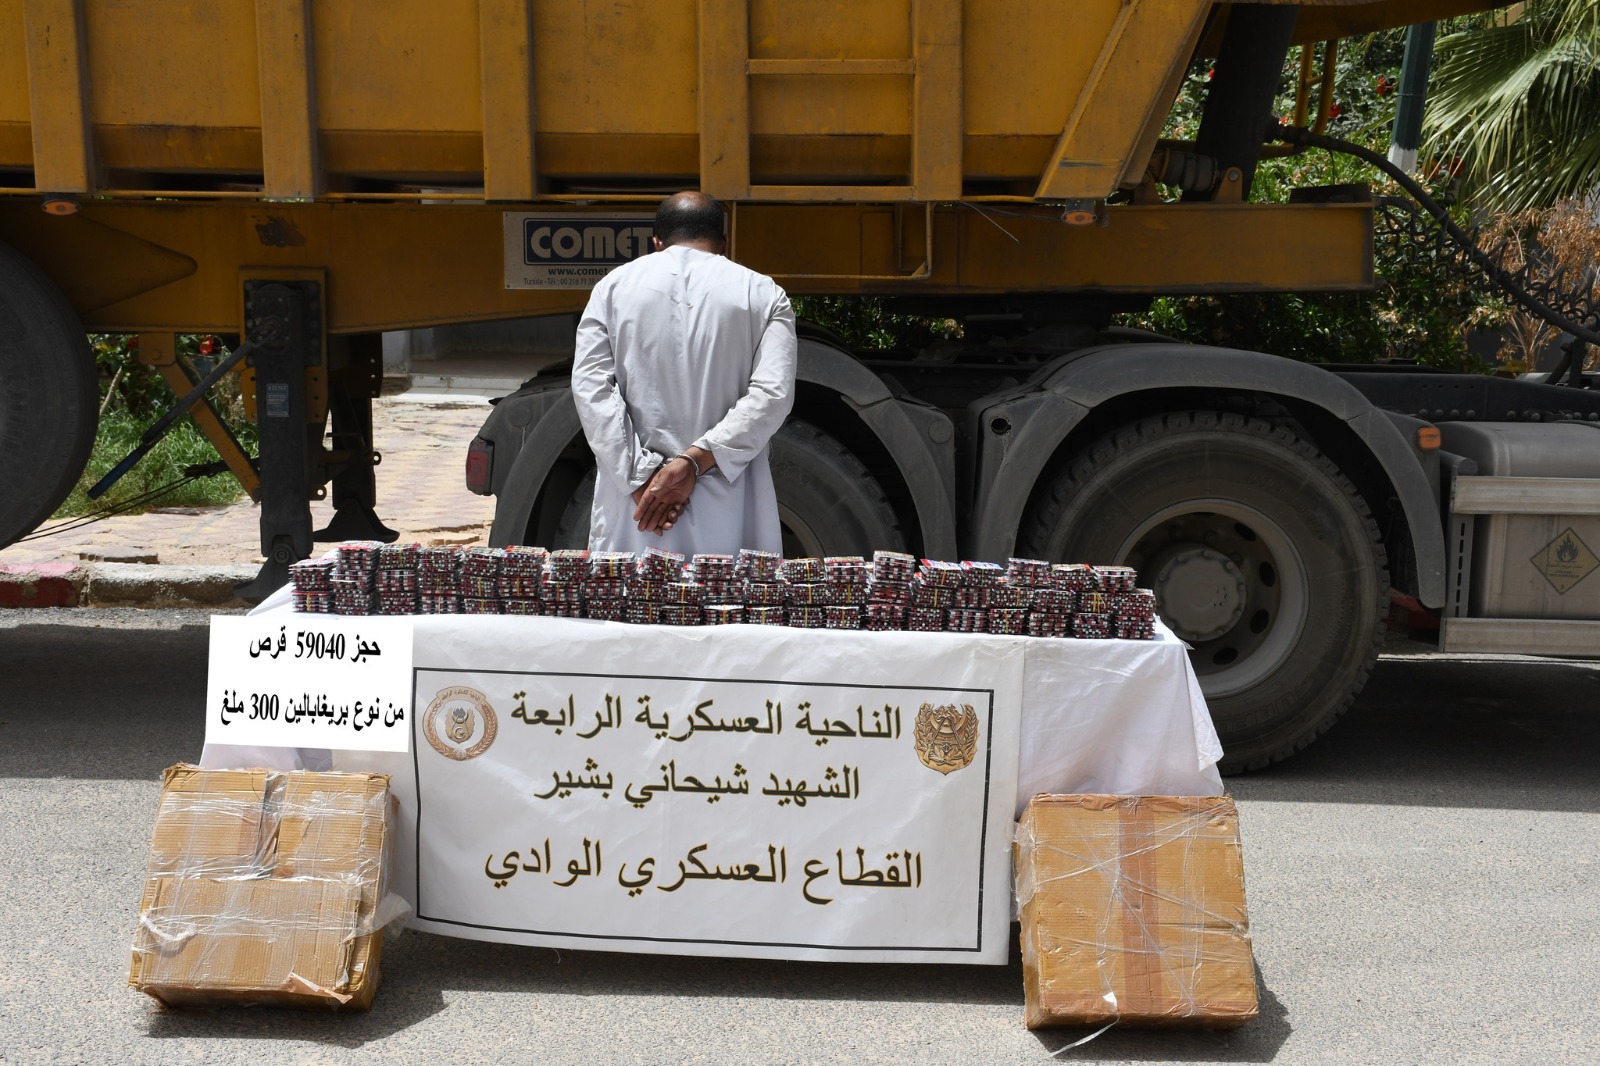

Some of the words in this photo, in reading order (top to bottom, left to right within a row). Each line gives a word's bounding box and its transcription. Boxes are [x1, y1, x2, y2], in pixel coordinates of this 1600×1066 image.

[530, 226, 654, 259] COMET
[249, 625, 287, 660] قرص
[295, 630, 346, 660] 59040
[350, 634, 381, 663] حجز
[220, 689, 245, 726] ملغ
[248, 693, 280, 721] 300
[285, 692, 349, 725] بريغابالين
[353, 697, 380, 731] نوع
[384, 702, 404, 728] من
[510, 690, 622, 739] الرابعة
[634, 695, 782, 743] العسكرية
[795, 701, 902, 748] الناحية
[533, 757, 613, 800] بشير
[624, 759, 749, 809] شيحاني
[762, 764, 860, 808] الشهيد
[484, 836, 602, 889] الوادي
[618, 843, 787, 898] العسكري
[802, 846, 923, 906] القطاع
